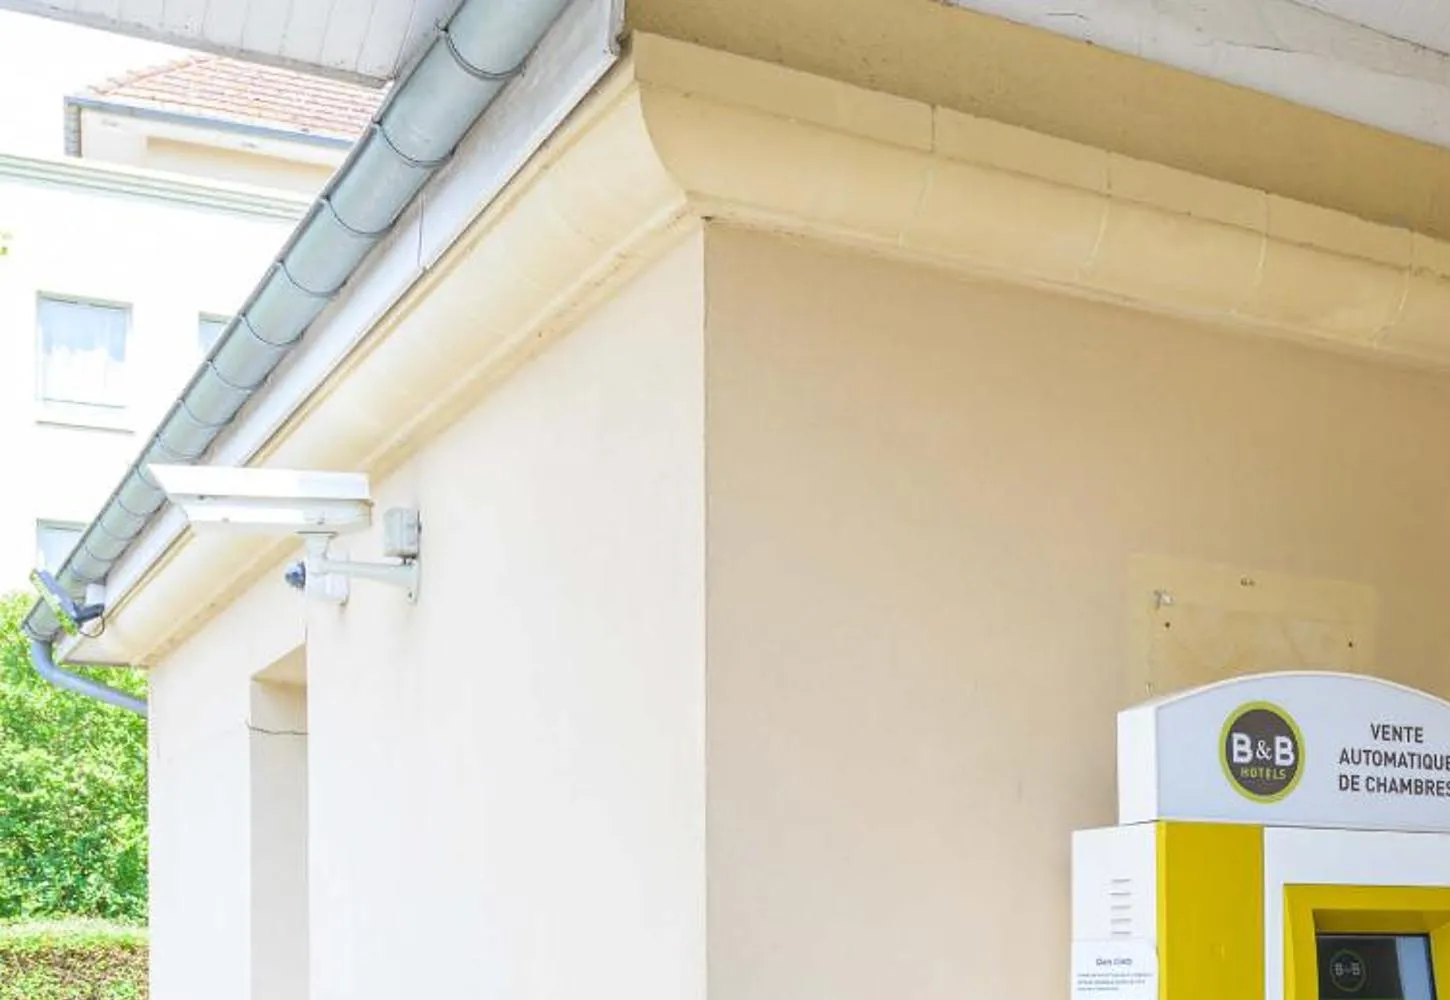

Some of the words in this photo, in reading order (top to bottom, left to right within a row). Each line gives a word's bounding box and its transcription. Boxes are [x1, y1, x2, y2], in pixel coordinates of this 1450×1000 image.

[1370, 723, 1424, 744] VENTE
[1232, 732, 1295, 767] B&B
[1240, 767, 1286, 780] HOTELS
[1339, 774, 1360, 792] DE
